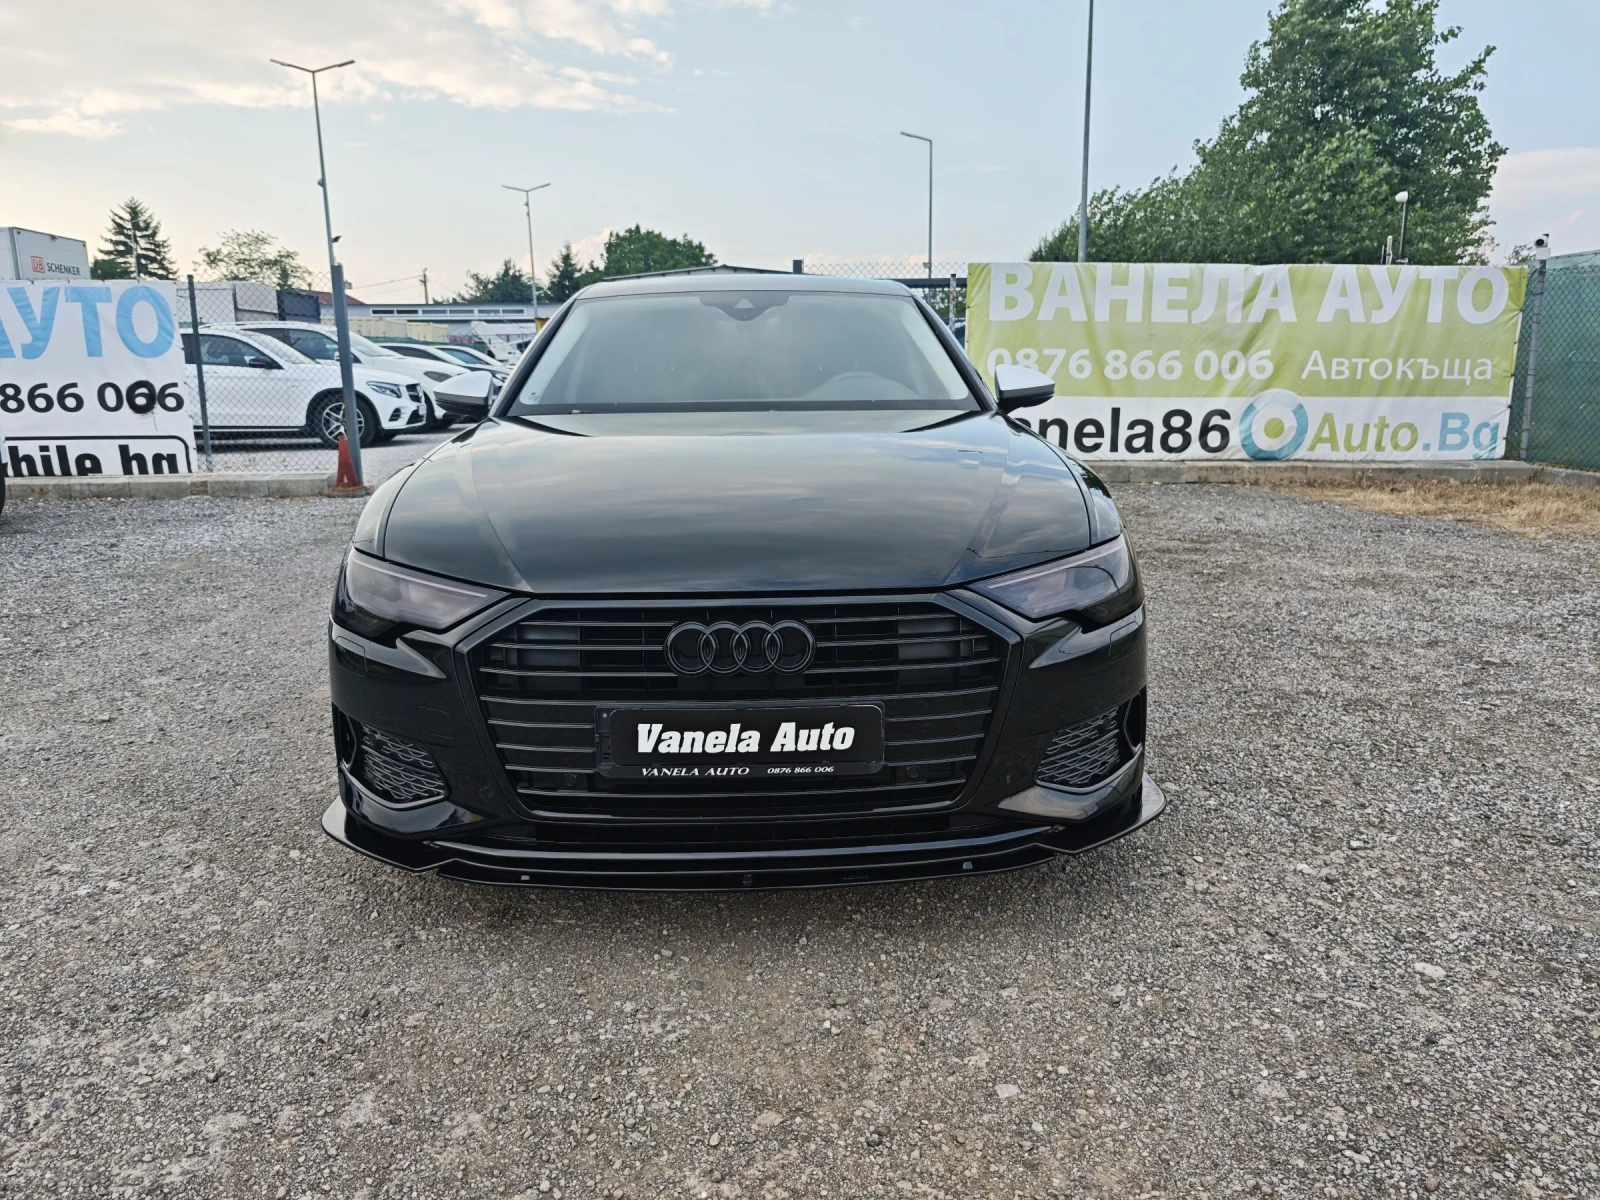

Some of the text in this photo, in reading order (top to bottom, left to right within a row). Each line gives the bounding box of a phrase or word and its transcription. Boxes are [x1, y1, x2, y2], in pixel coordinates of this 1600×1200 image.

[32, 258, 82, 276] DB SCHENKER
[988, 264, 1510, 325] ВАНЕЛА АУТО
[1103, 349, 1183, 381] 866
[1194, 350, 1275, 381] 006
[1300, 350, 1493, 386] Автокъща
[0, 382, 84, 413] 866
[1014, 407, 1231, 454] nela86
[1307, 411, 1500, 460] Auto.Bg
[637, 721, 856, 754] Vanela Auto
[641, 765, 835, 777] VANELA AUTO 0876 866 006
